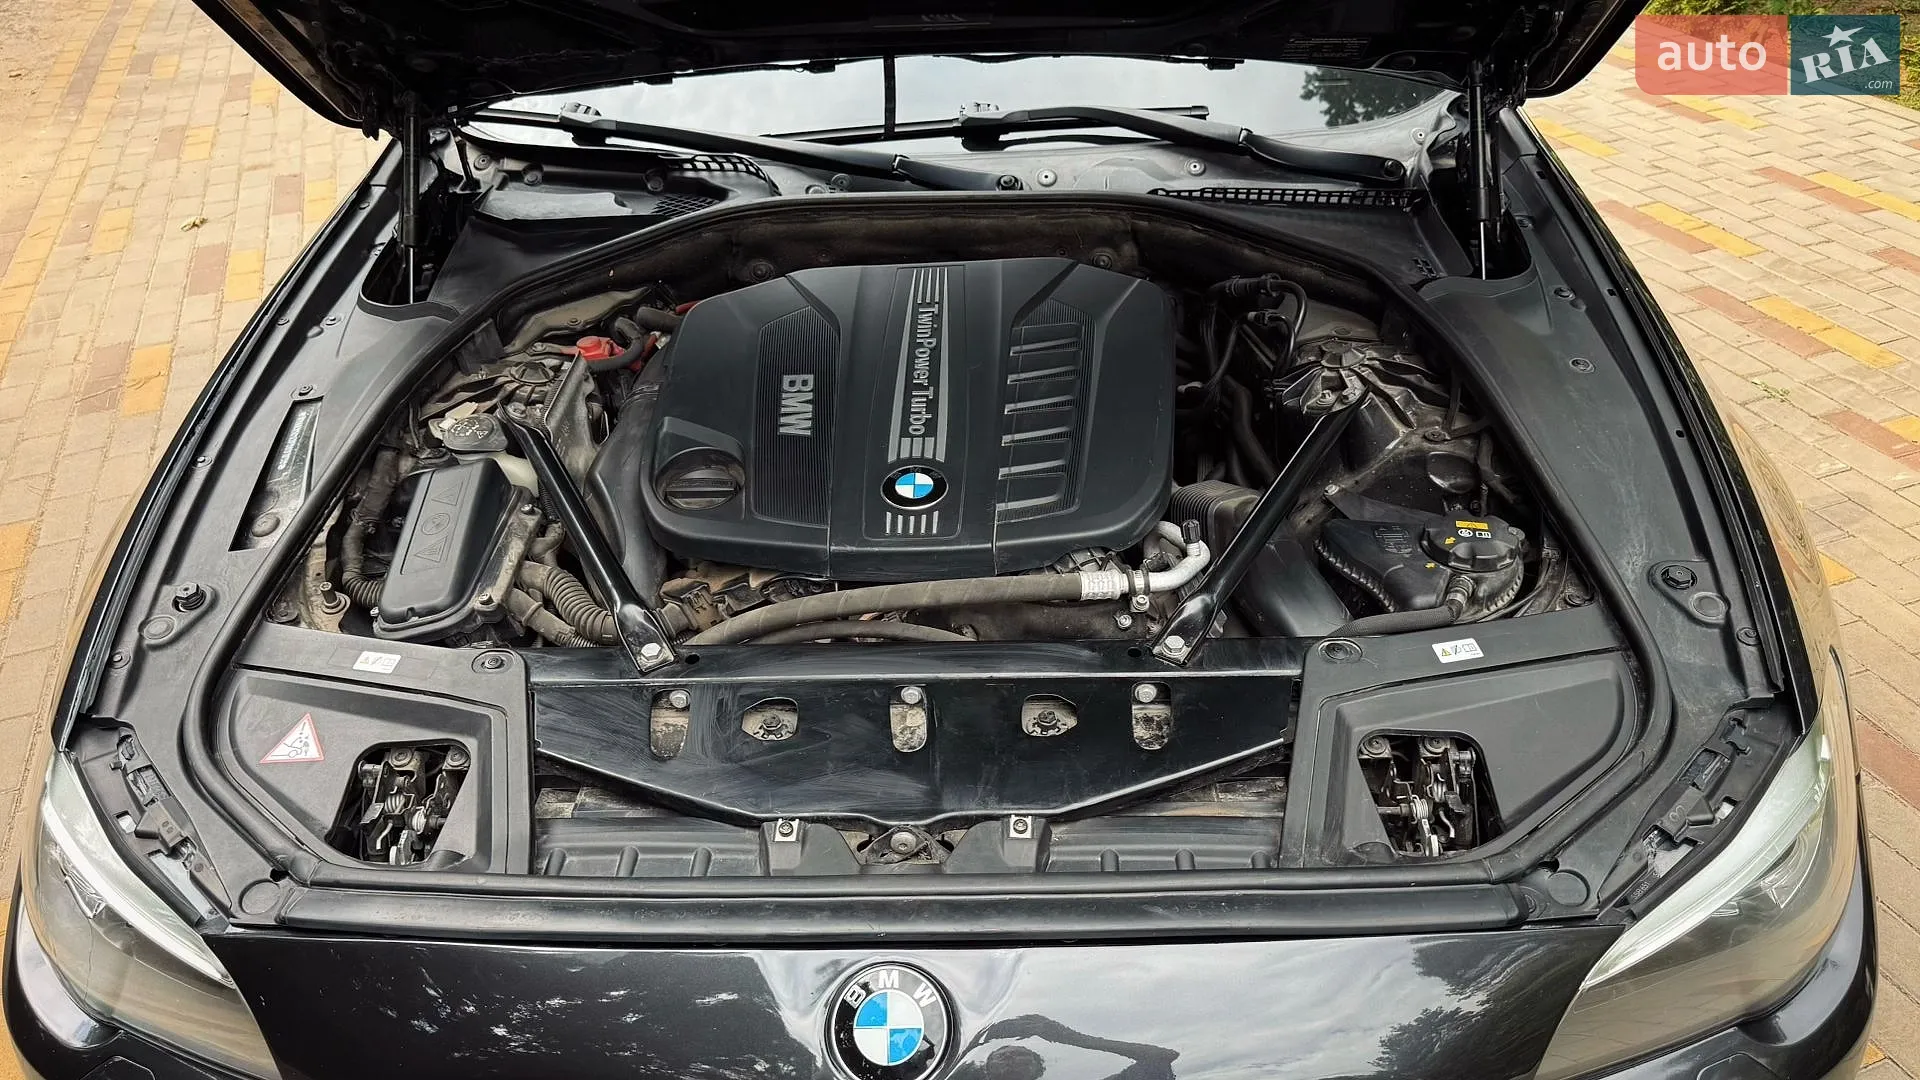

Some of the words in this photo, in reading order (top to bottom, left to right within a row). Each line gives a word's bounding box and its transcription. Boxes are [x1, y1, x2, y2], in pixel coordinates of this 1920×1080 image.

[912, 303, 939, 386] TwinPower
[778, 374, 814, 436] BMW
[908, 386, 934, 435] Turbo
[844, 969, 937, 1009] BMW
